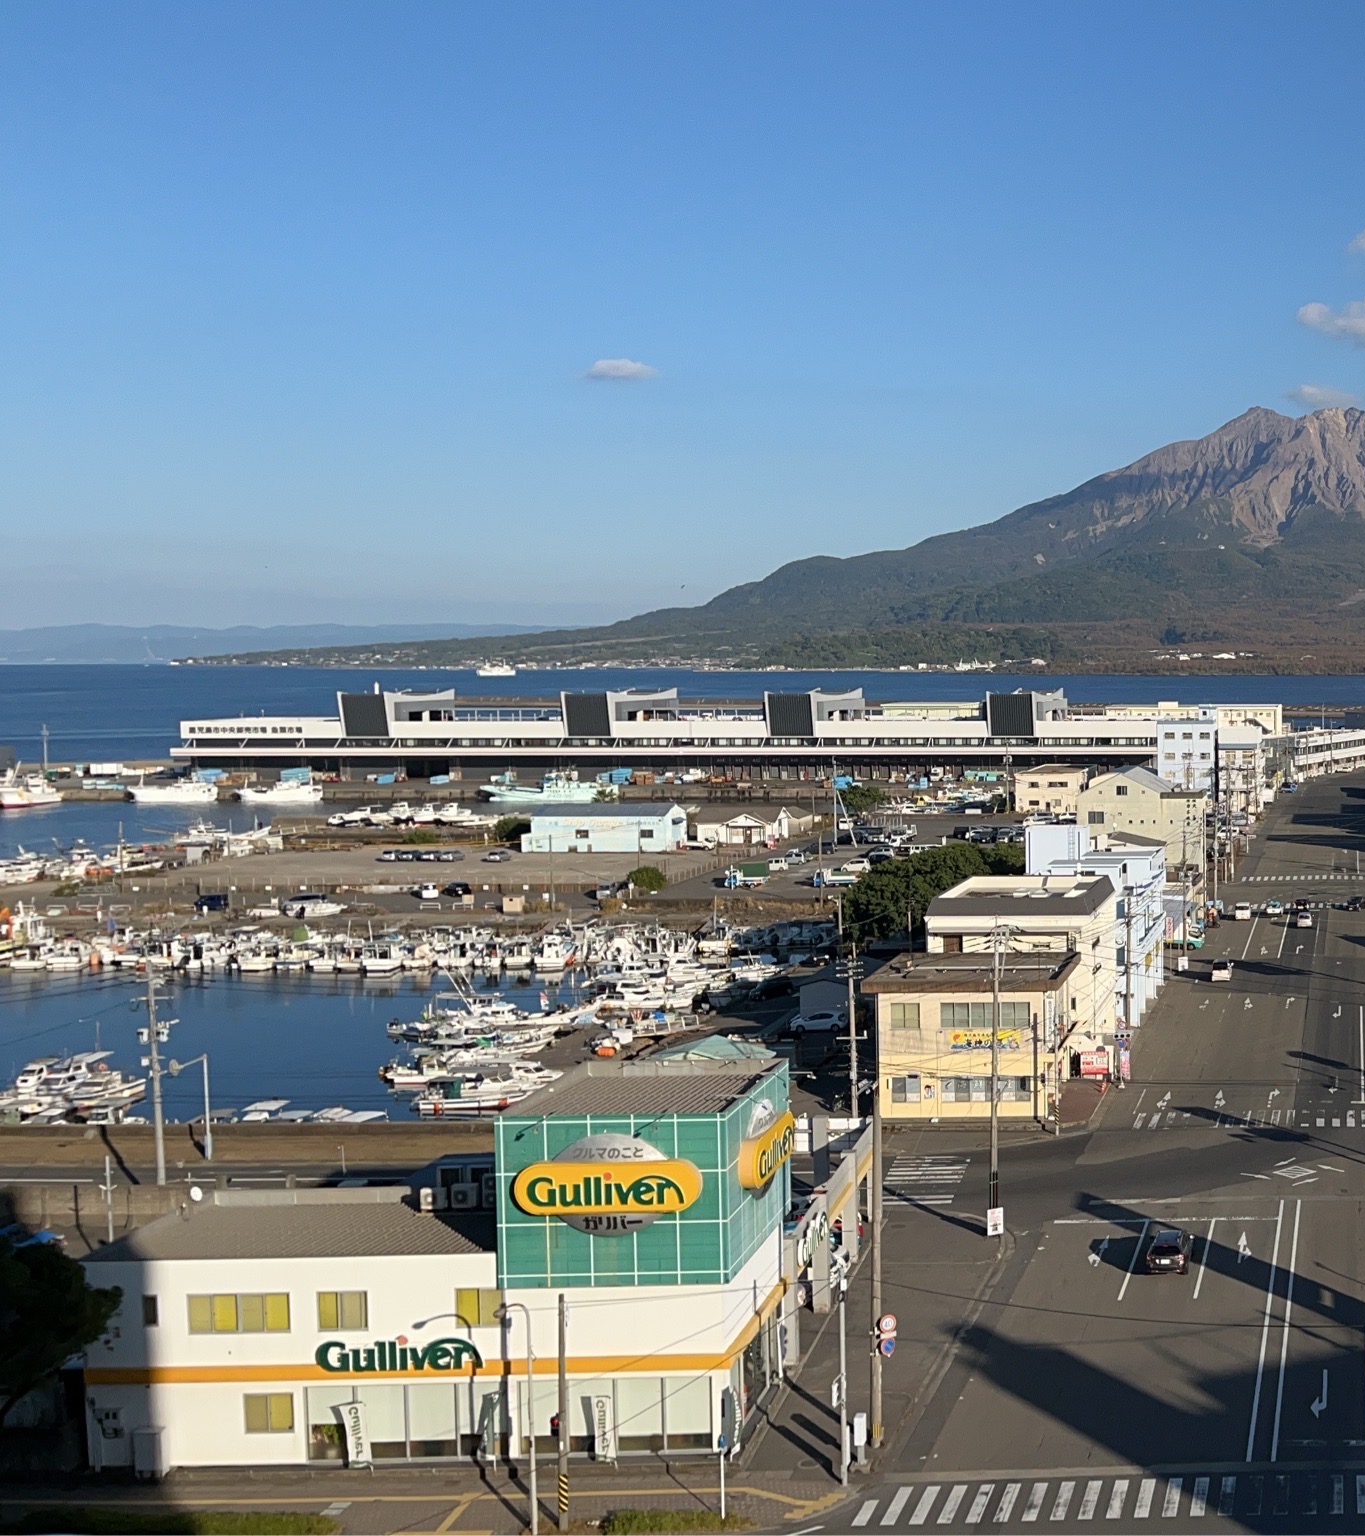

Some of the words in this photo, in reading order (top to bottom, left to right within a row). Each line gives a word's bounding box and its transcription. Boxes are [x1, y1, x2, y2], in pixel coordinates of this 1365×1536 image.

[572, 1146, 644, 1160] クルマのこと
[759, 1125, 793, 1179] Gulliver
[526, 1172, 685, 1208] Gulliver
[582, 1215, 643, 1230] ガリバー
[315, 1334, 483, 1373] Gulliver
